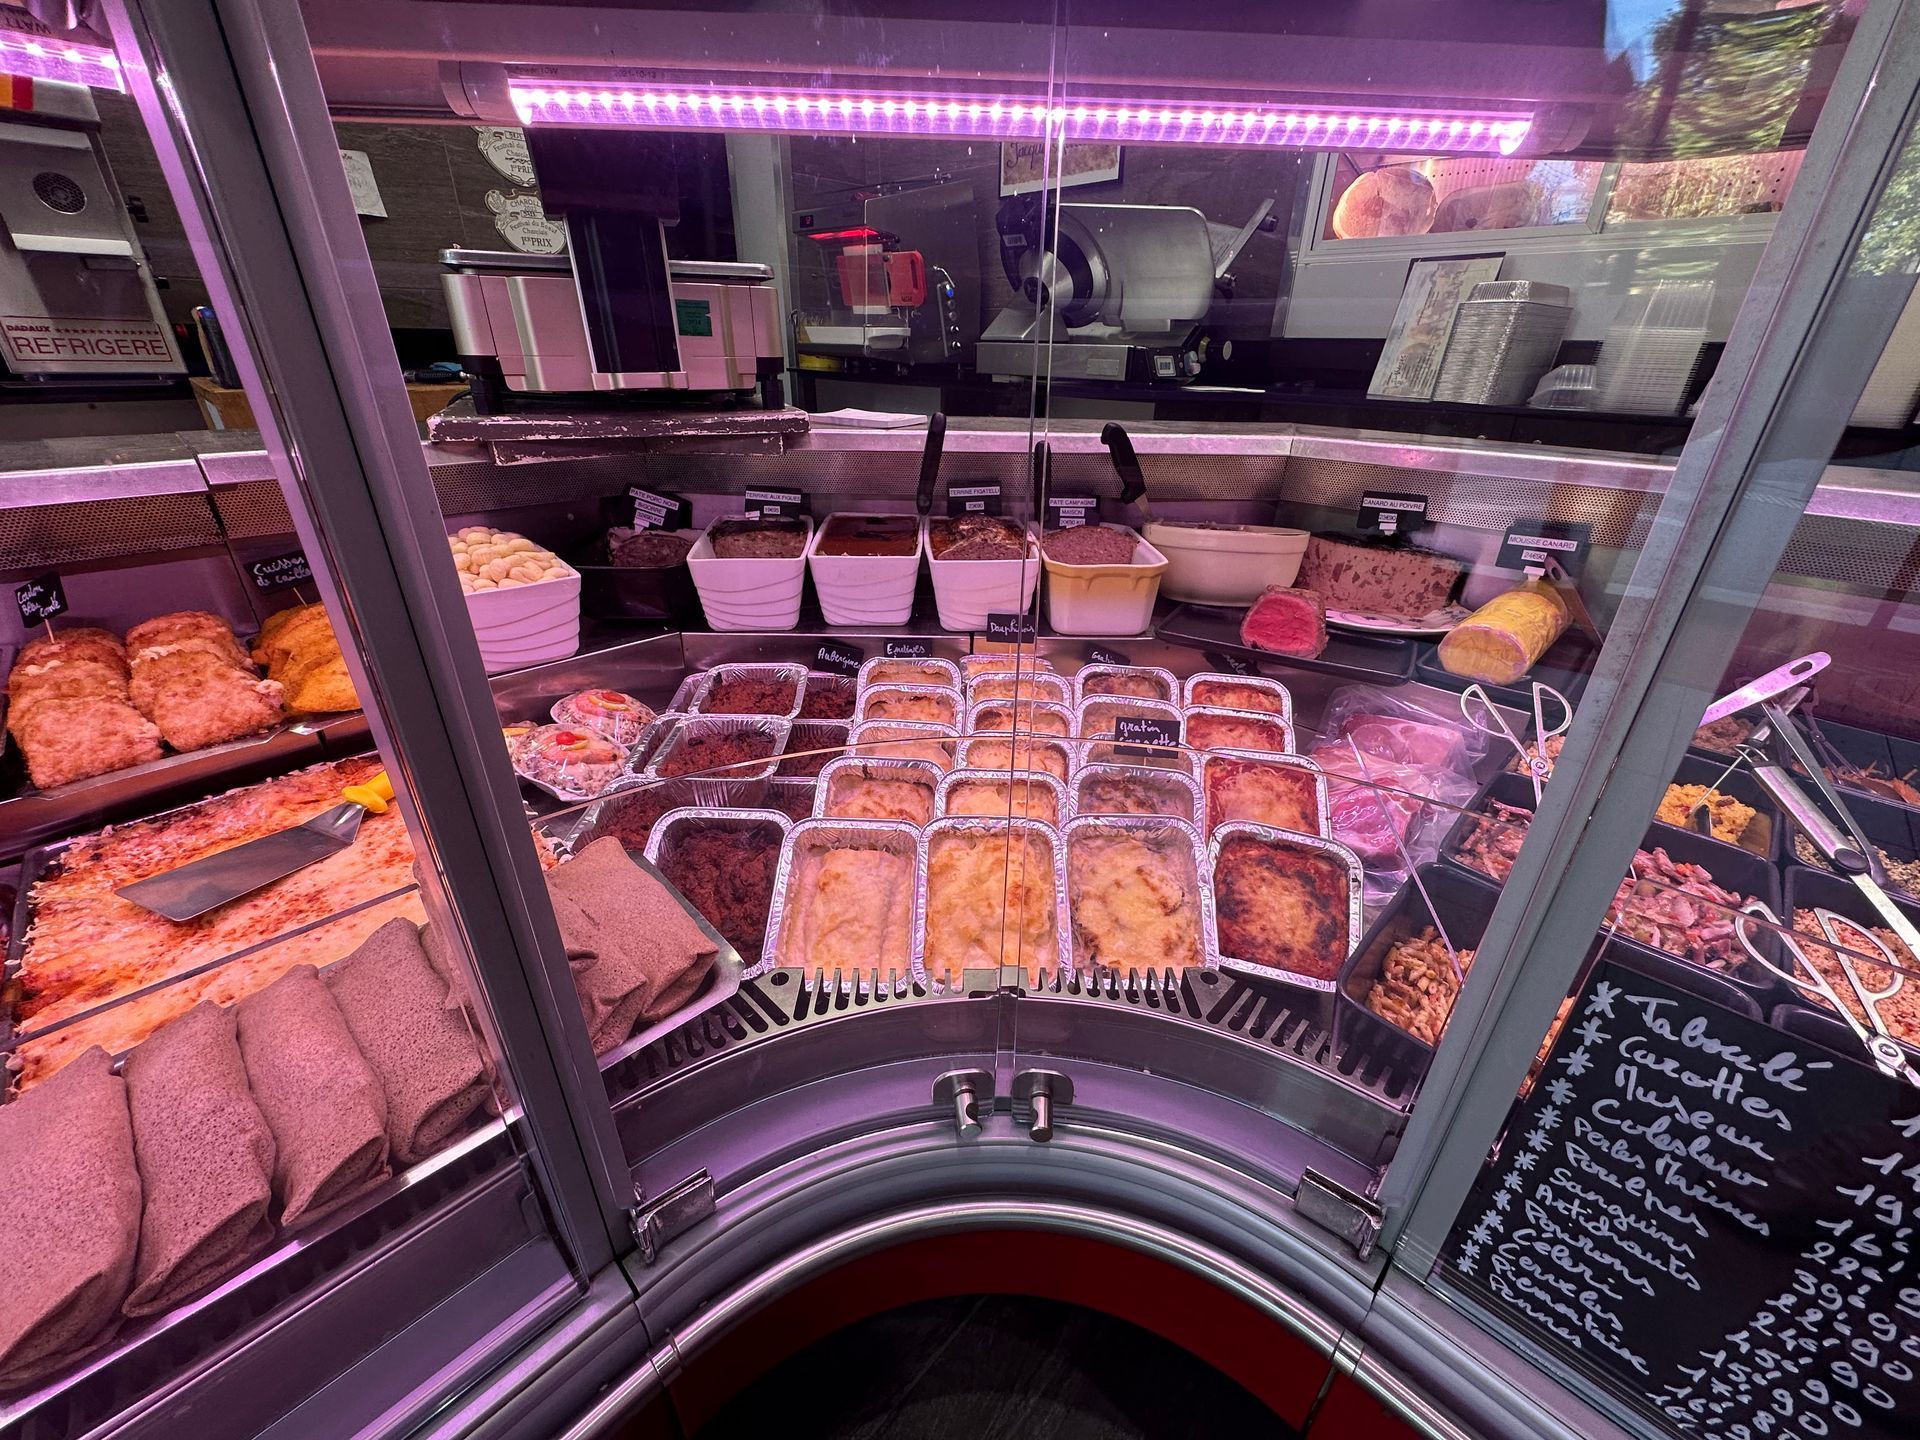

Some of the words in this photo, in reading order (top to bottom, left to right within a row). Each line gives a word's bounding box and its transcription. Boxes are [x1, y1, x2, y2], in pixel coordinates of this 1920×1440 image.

[6, 324, 51, 333] DADAUX
[12, 336, 168, 356] REFRIGERE
[1363, 498, 1389, 507] CANARD
[1399, 502, 1423, 510] POIVRE
[1509, 535, 1541, 546] MOUSSE
[1542, 539, 1575, 549] CANARD
[990, 618, 1035, 637] Dauphiois
[1624, 993, 1833, 1092] Taboulé
[1618, 1035, 1792, 1132] Carottes
[1615, 1063, 1775, 1162] Museau
[1572, 1115, 1646, 1170] Perles
[1591, 1098, 1769, 1188] Coleslaw
